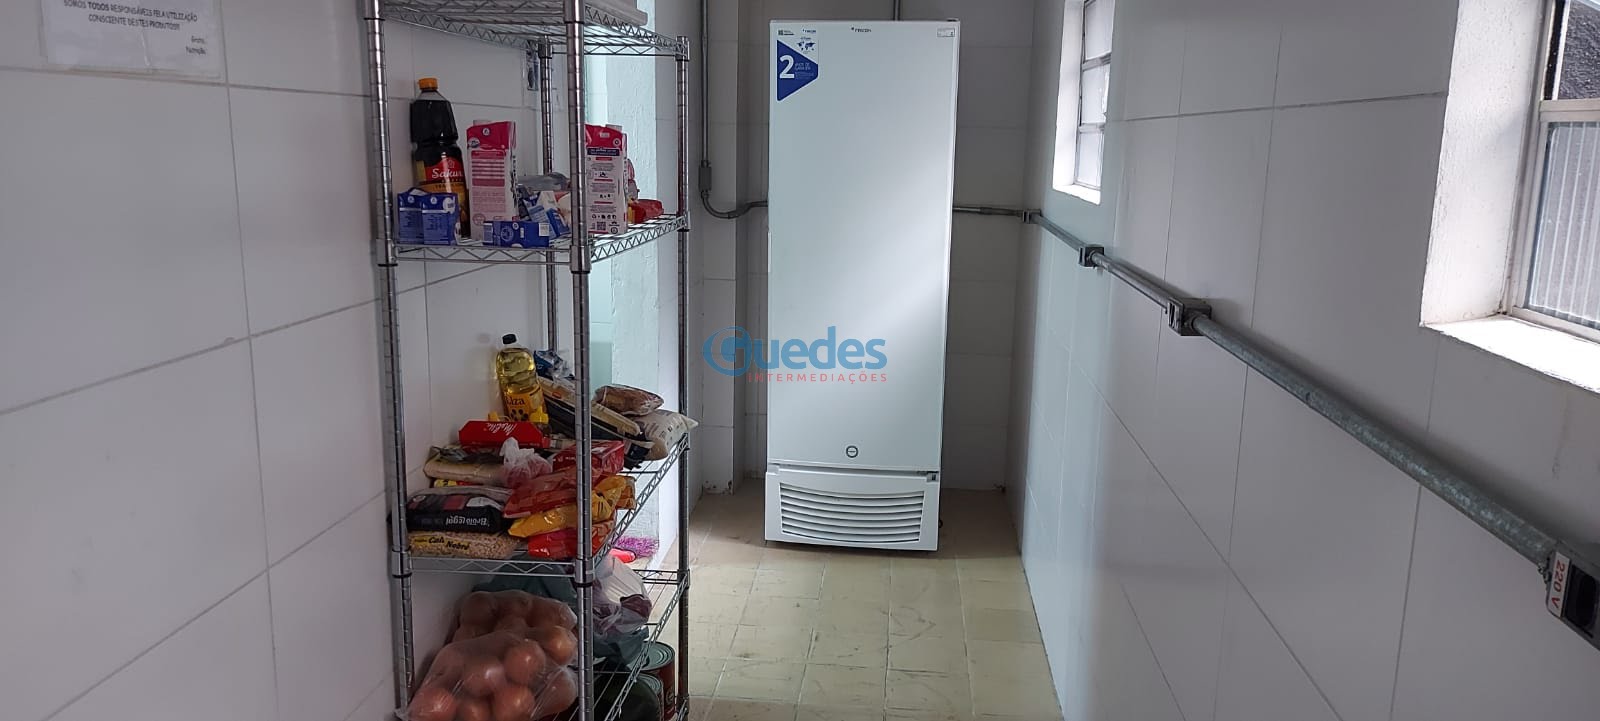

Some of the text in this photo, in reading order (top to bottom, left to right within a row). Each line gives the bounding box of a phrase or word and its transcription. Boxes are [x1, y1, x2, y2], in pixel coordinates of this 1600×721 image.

[88, 1, 109, 11] TODOS
[779, 54, 795, 79] 2
[1551, 560, 1566, 609] 220 V
